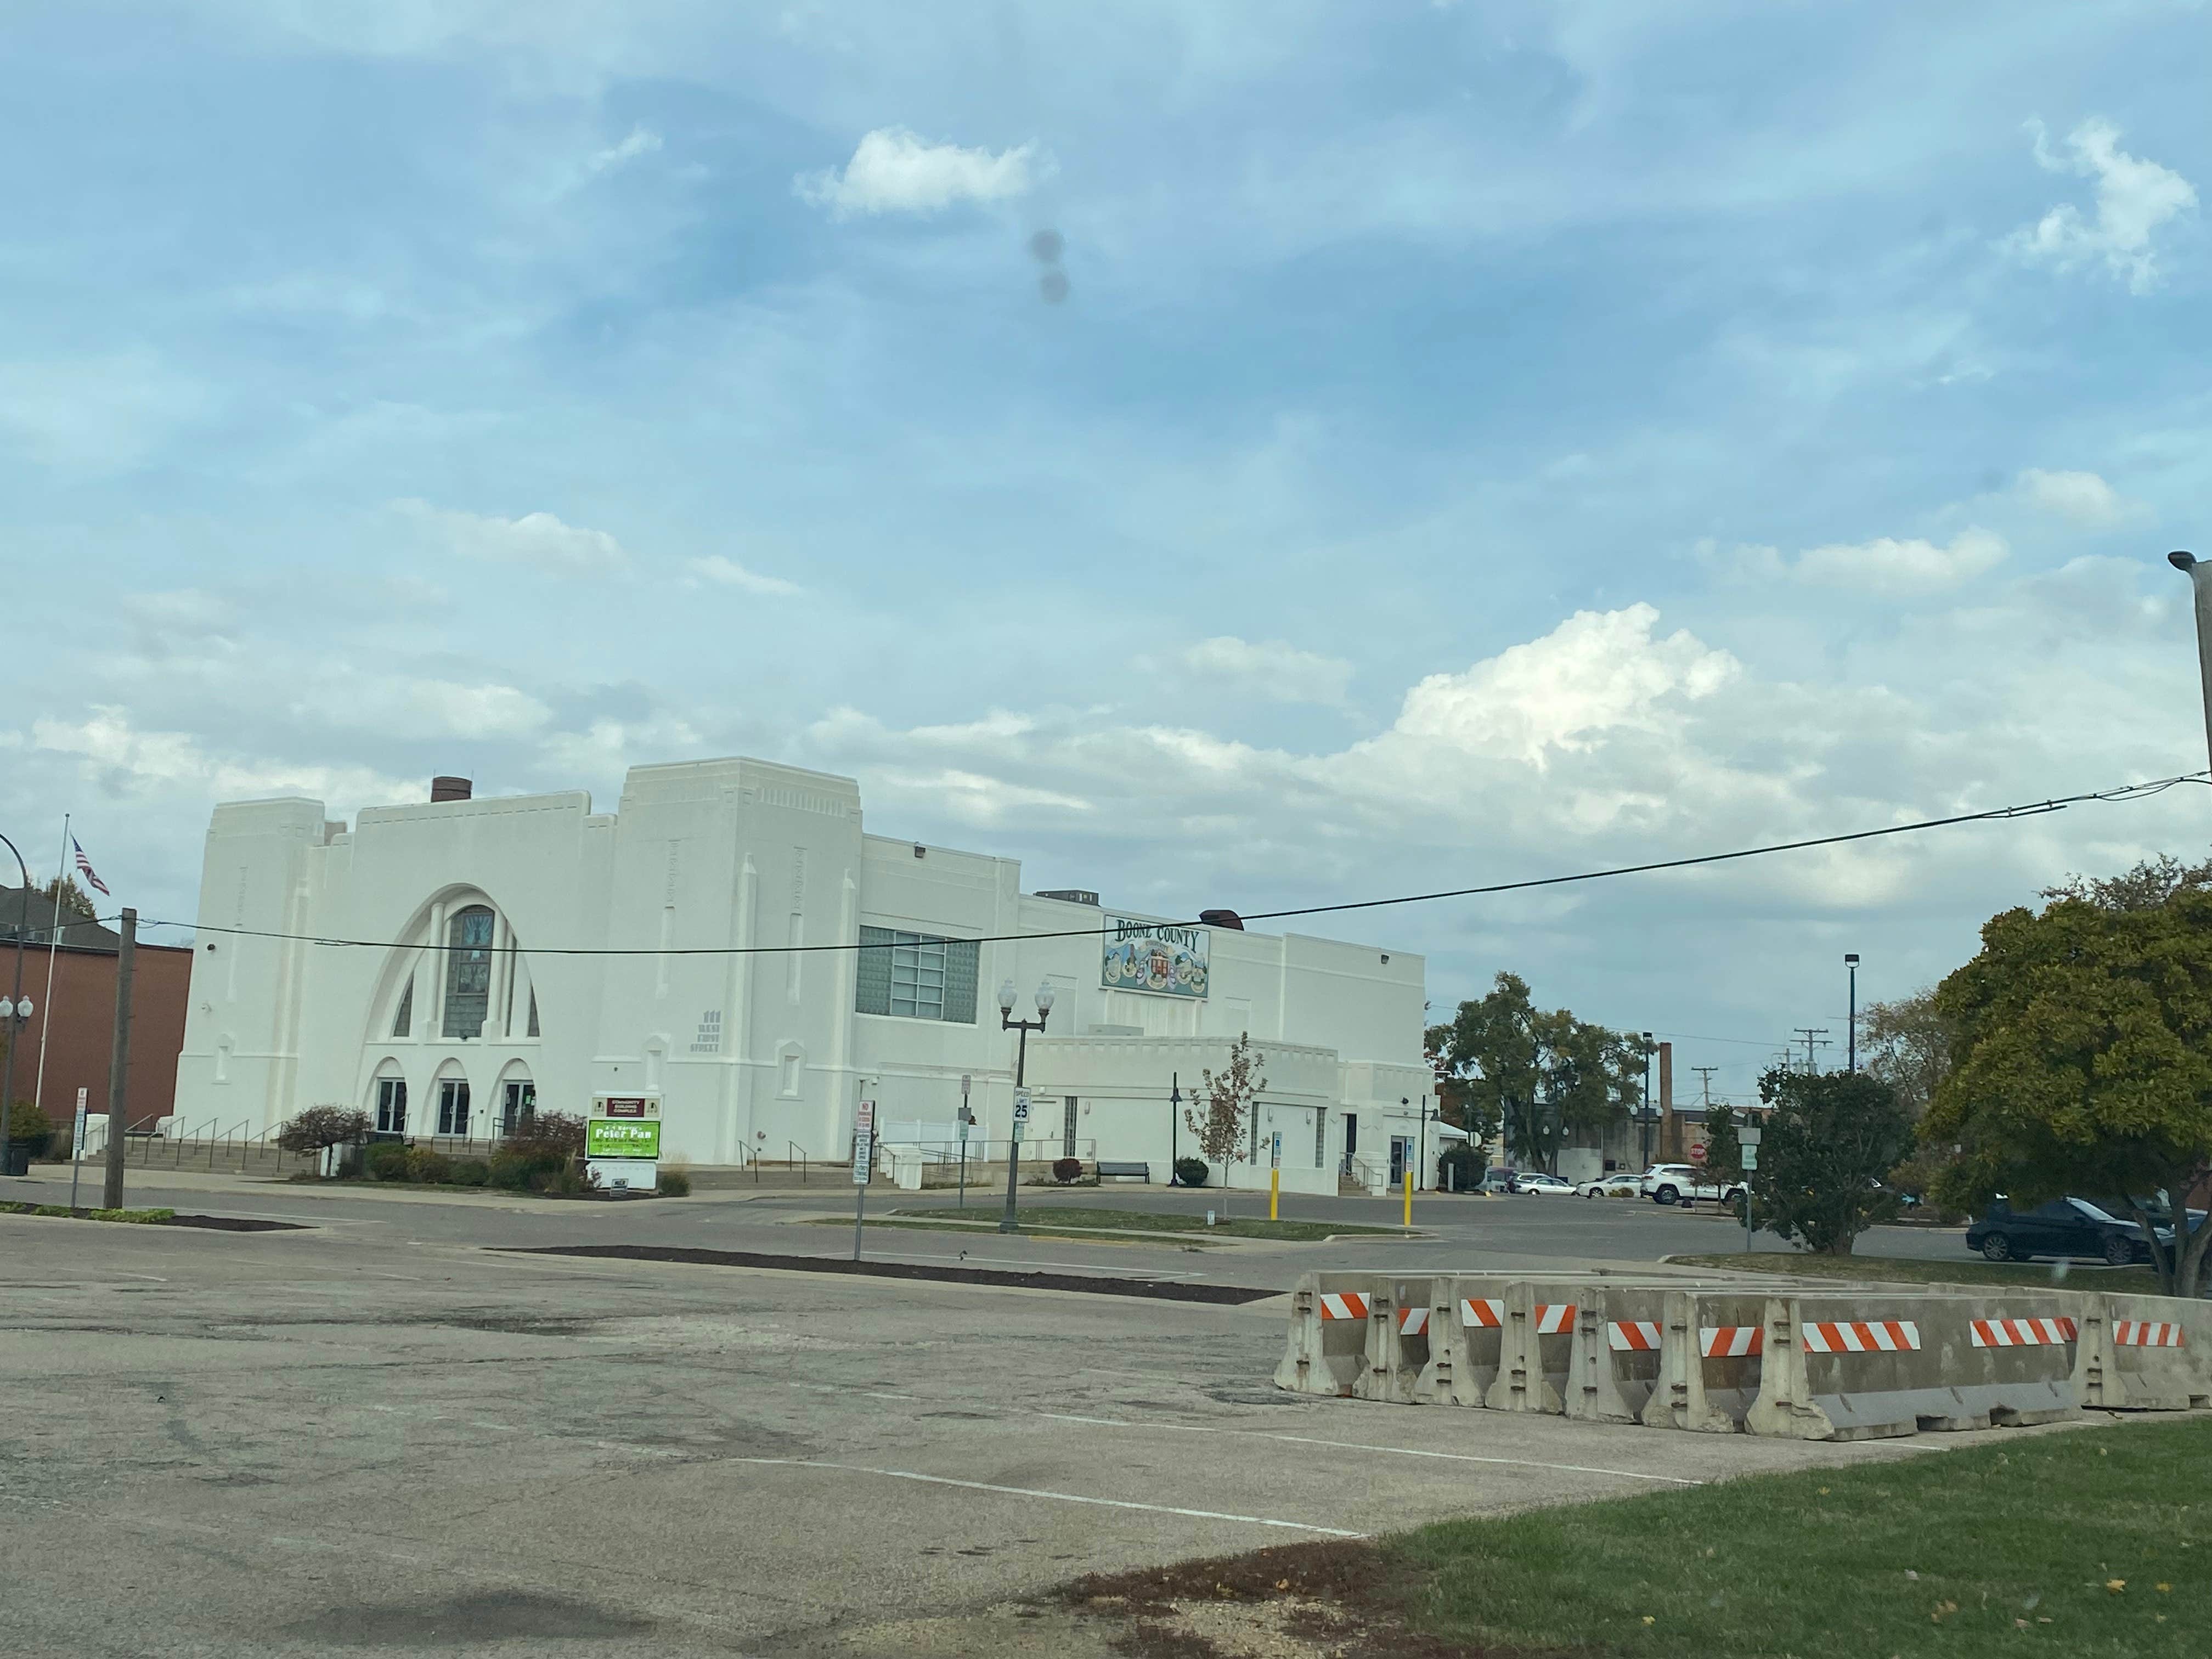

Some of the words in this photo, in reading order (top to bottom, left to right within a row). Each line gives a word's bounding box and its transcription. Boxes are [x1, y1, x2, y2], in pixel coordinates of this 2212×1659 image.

[1115, 919, 1152, 942] BOONE
[1157, 925, 1199, 953] COUNTY
[703, 1010, 720, 1023] 111
[1015, 1105, 1028, 1118] 25
[596, 1128, 627, 1138] Peter
[630, 1130, 652, 1138] Pan
